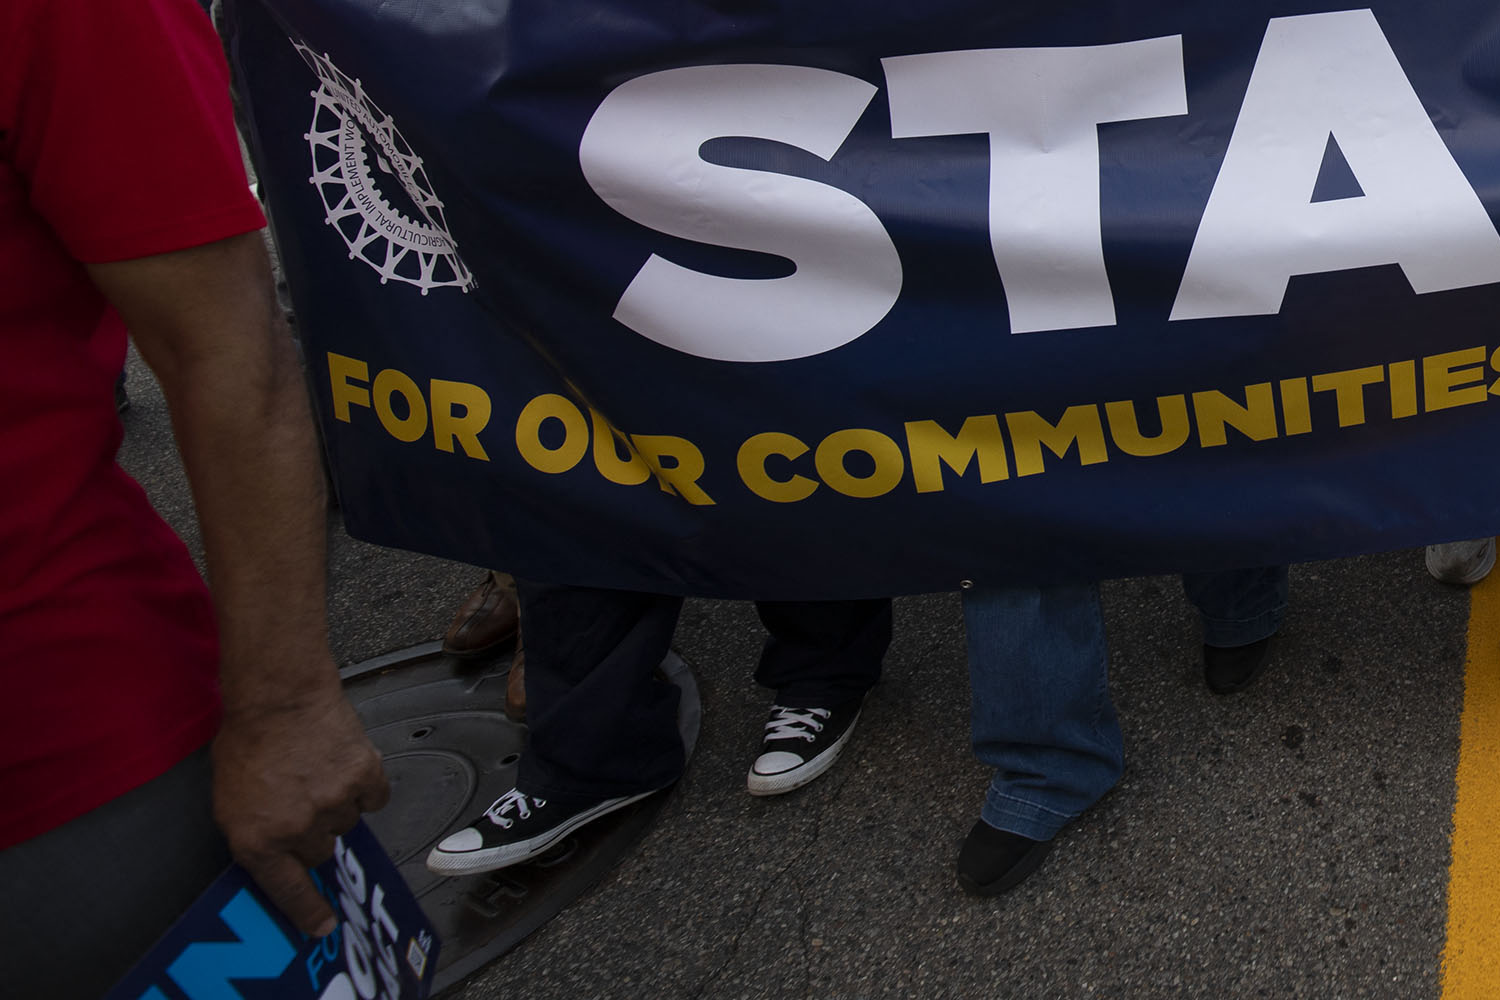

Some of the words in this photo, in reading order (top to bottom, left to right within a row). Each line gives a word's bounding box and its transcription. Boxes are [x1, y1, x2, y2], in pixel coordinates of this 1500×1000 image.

[345, 143, 377, 214] IMPLEMENT
[327, 351, 492, 462] FOR
[515, 393, 717, 506] OUR
